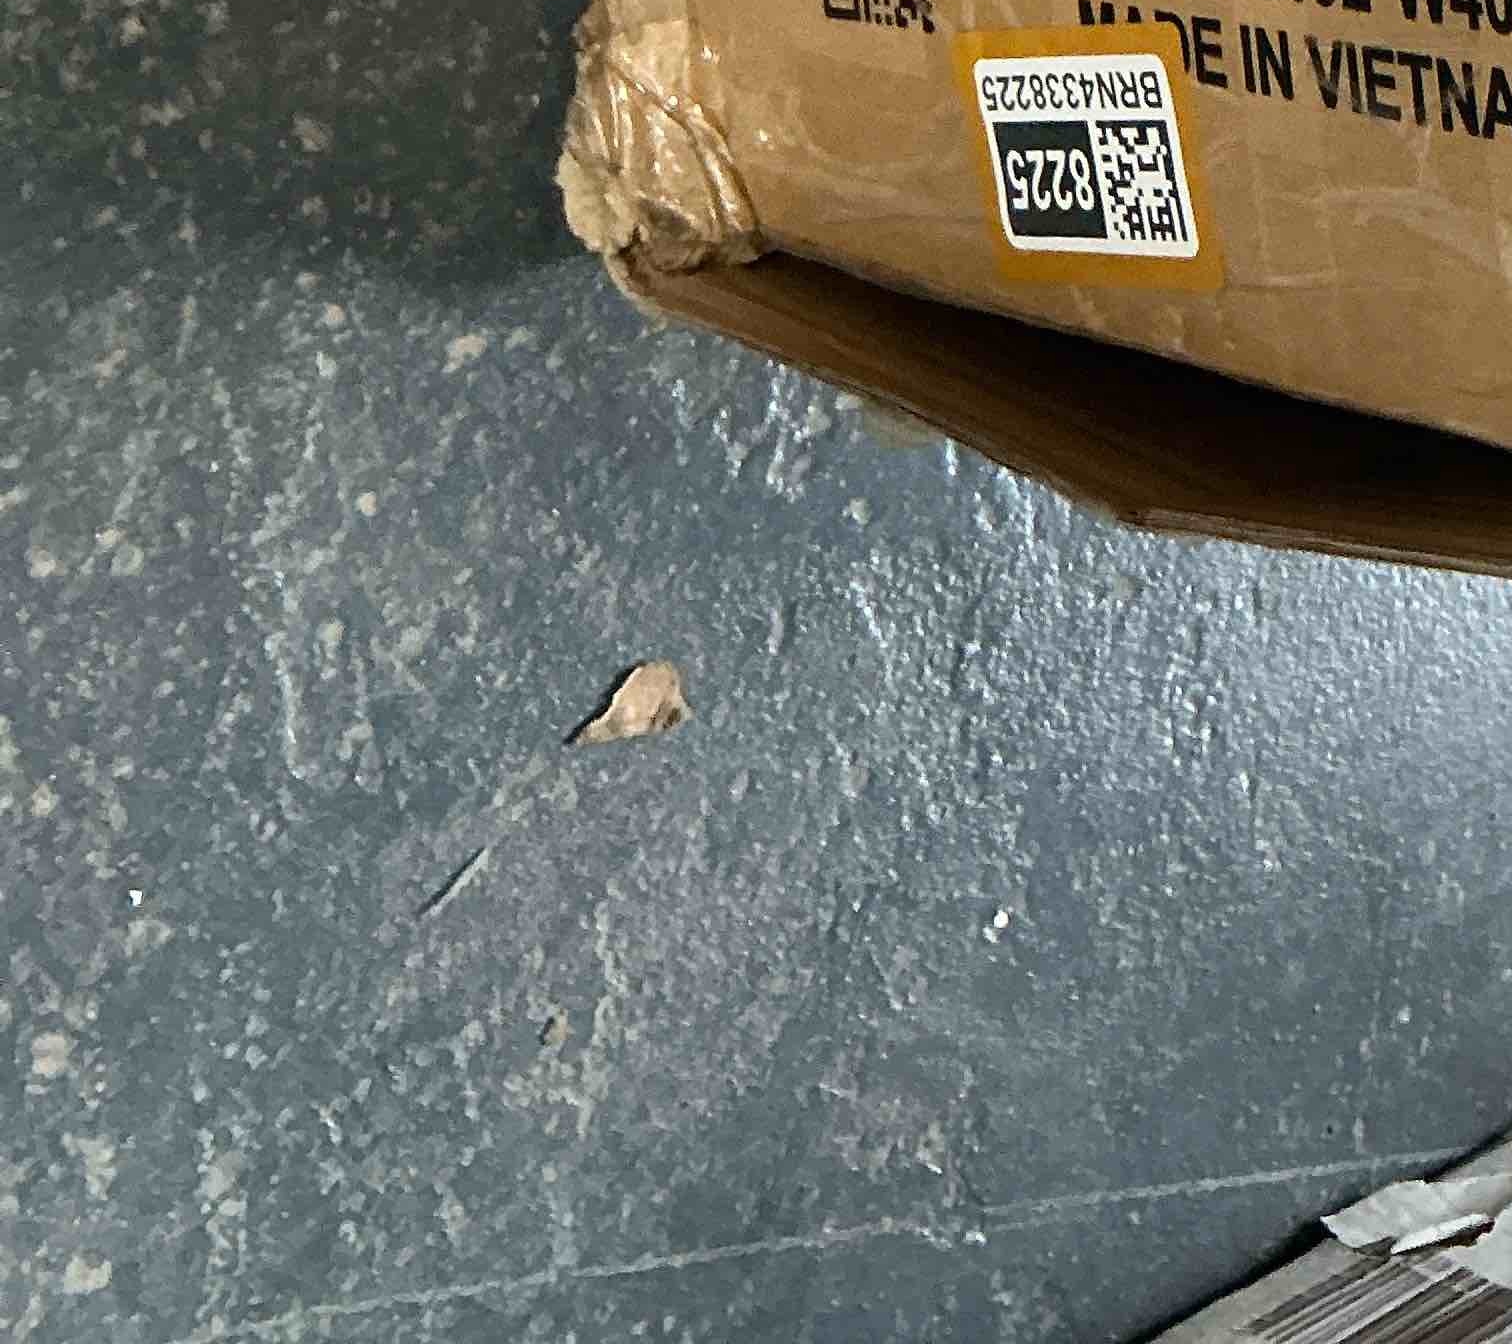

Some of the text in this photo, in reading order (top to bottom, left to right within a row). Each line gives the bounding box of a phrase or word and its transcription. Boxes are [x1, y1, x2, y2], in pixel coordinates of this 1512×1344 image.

[982, 71, 1164, 110] BRN4338225
[1240, 26, 1294, 102] IN
[1007, 146, 1096, 212] 8225
